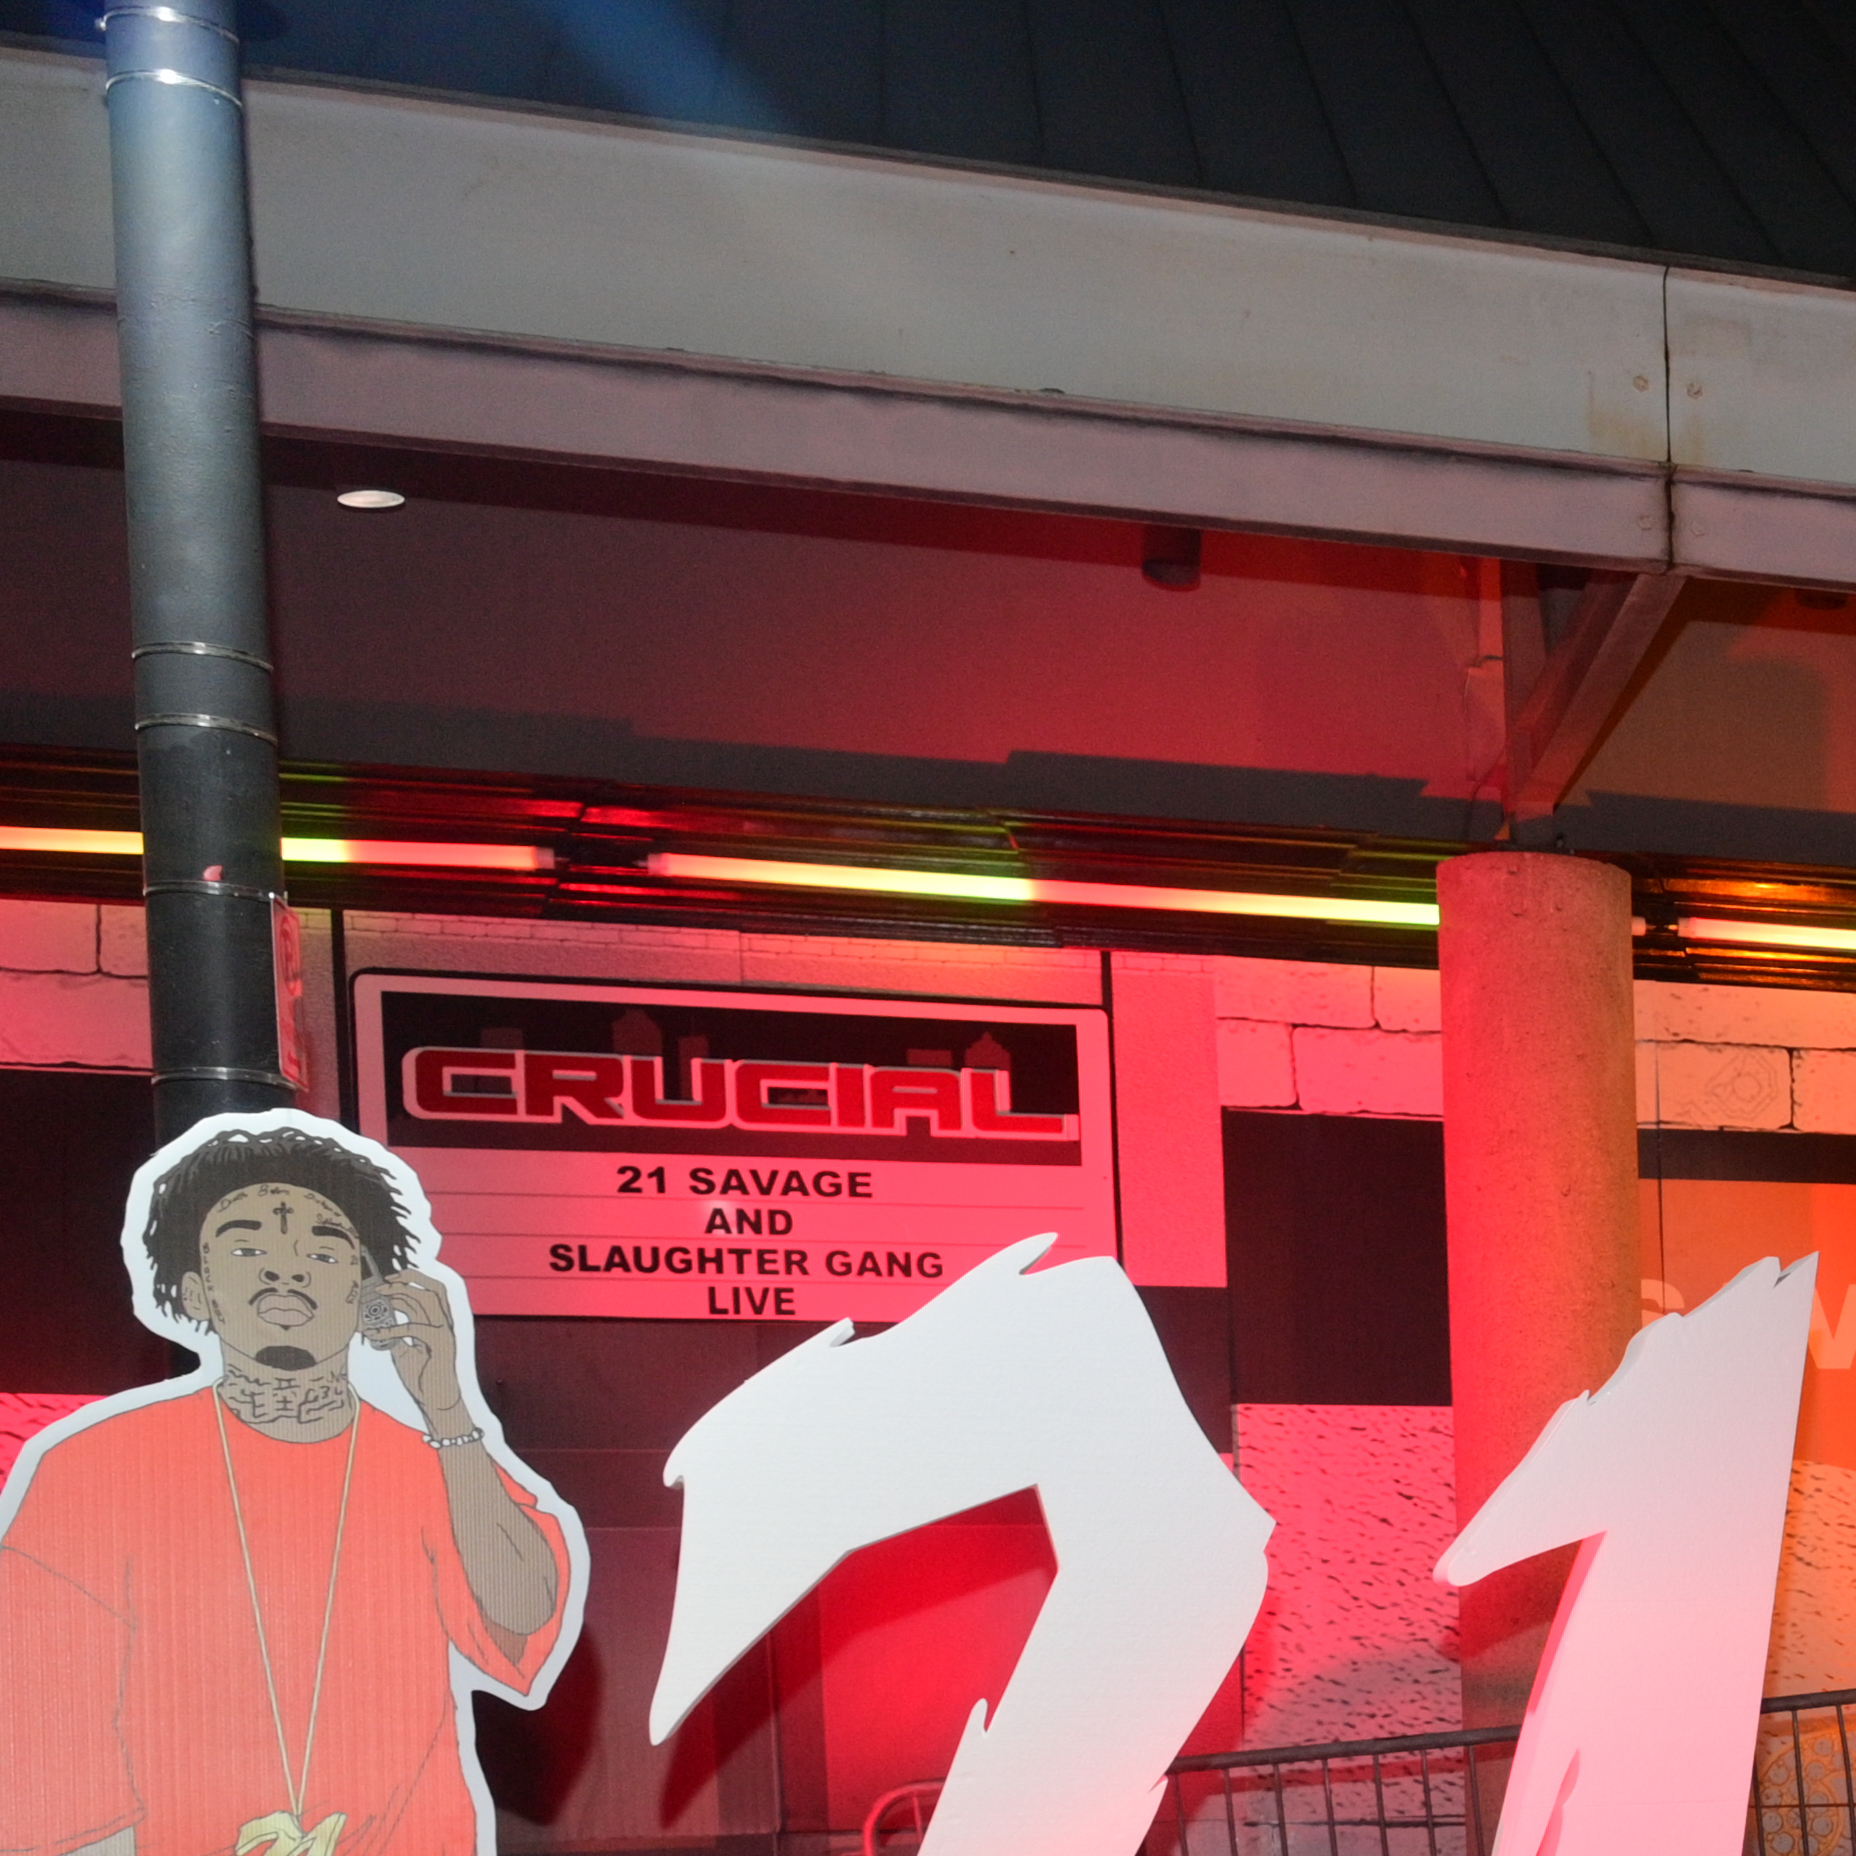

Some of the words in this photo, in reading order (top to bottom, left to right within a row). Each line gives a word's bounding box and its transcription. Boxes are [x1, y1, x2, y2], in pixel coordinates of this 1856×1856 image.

[402, 1046, 1080, 1141] CRUCIAL
[616, 1166, 667, 1194] 21
[689, 1167, 873, 1198] SAVAGE
[704, 1208, 794, 1237] AND
[549, 1244, 808, 1276] SLAUGHTER
[825, 1250, 943, 1278] GANG
[707, 1286, 796, 1316] LIVE
